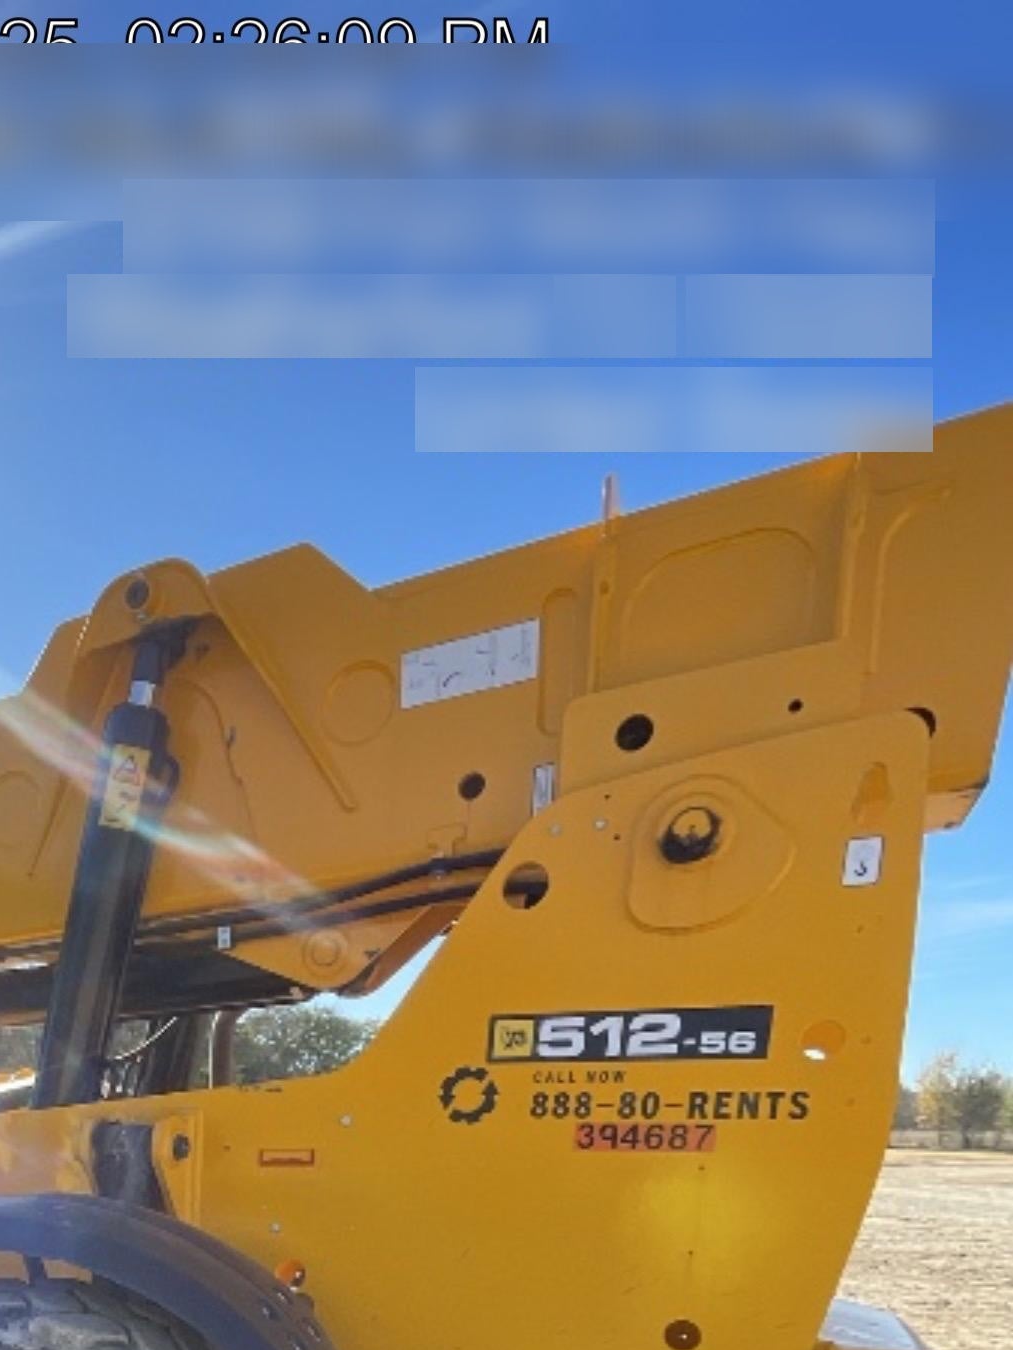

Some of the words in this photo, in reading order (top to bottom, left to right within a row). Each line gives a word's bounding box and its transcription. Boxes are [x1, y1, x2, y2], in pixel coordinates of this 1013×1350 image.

[537, 1013, 757, 1058] 512-56
[532, 1071, 577, 1084] CALL
[585, 1071, 627, 1084] NOW
[529, 1091, 811, 1120] 888-80-RENTS
[576, 1124, 715, 1150] 394687
